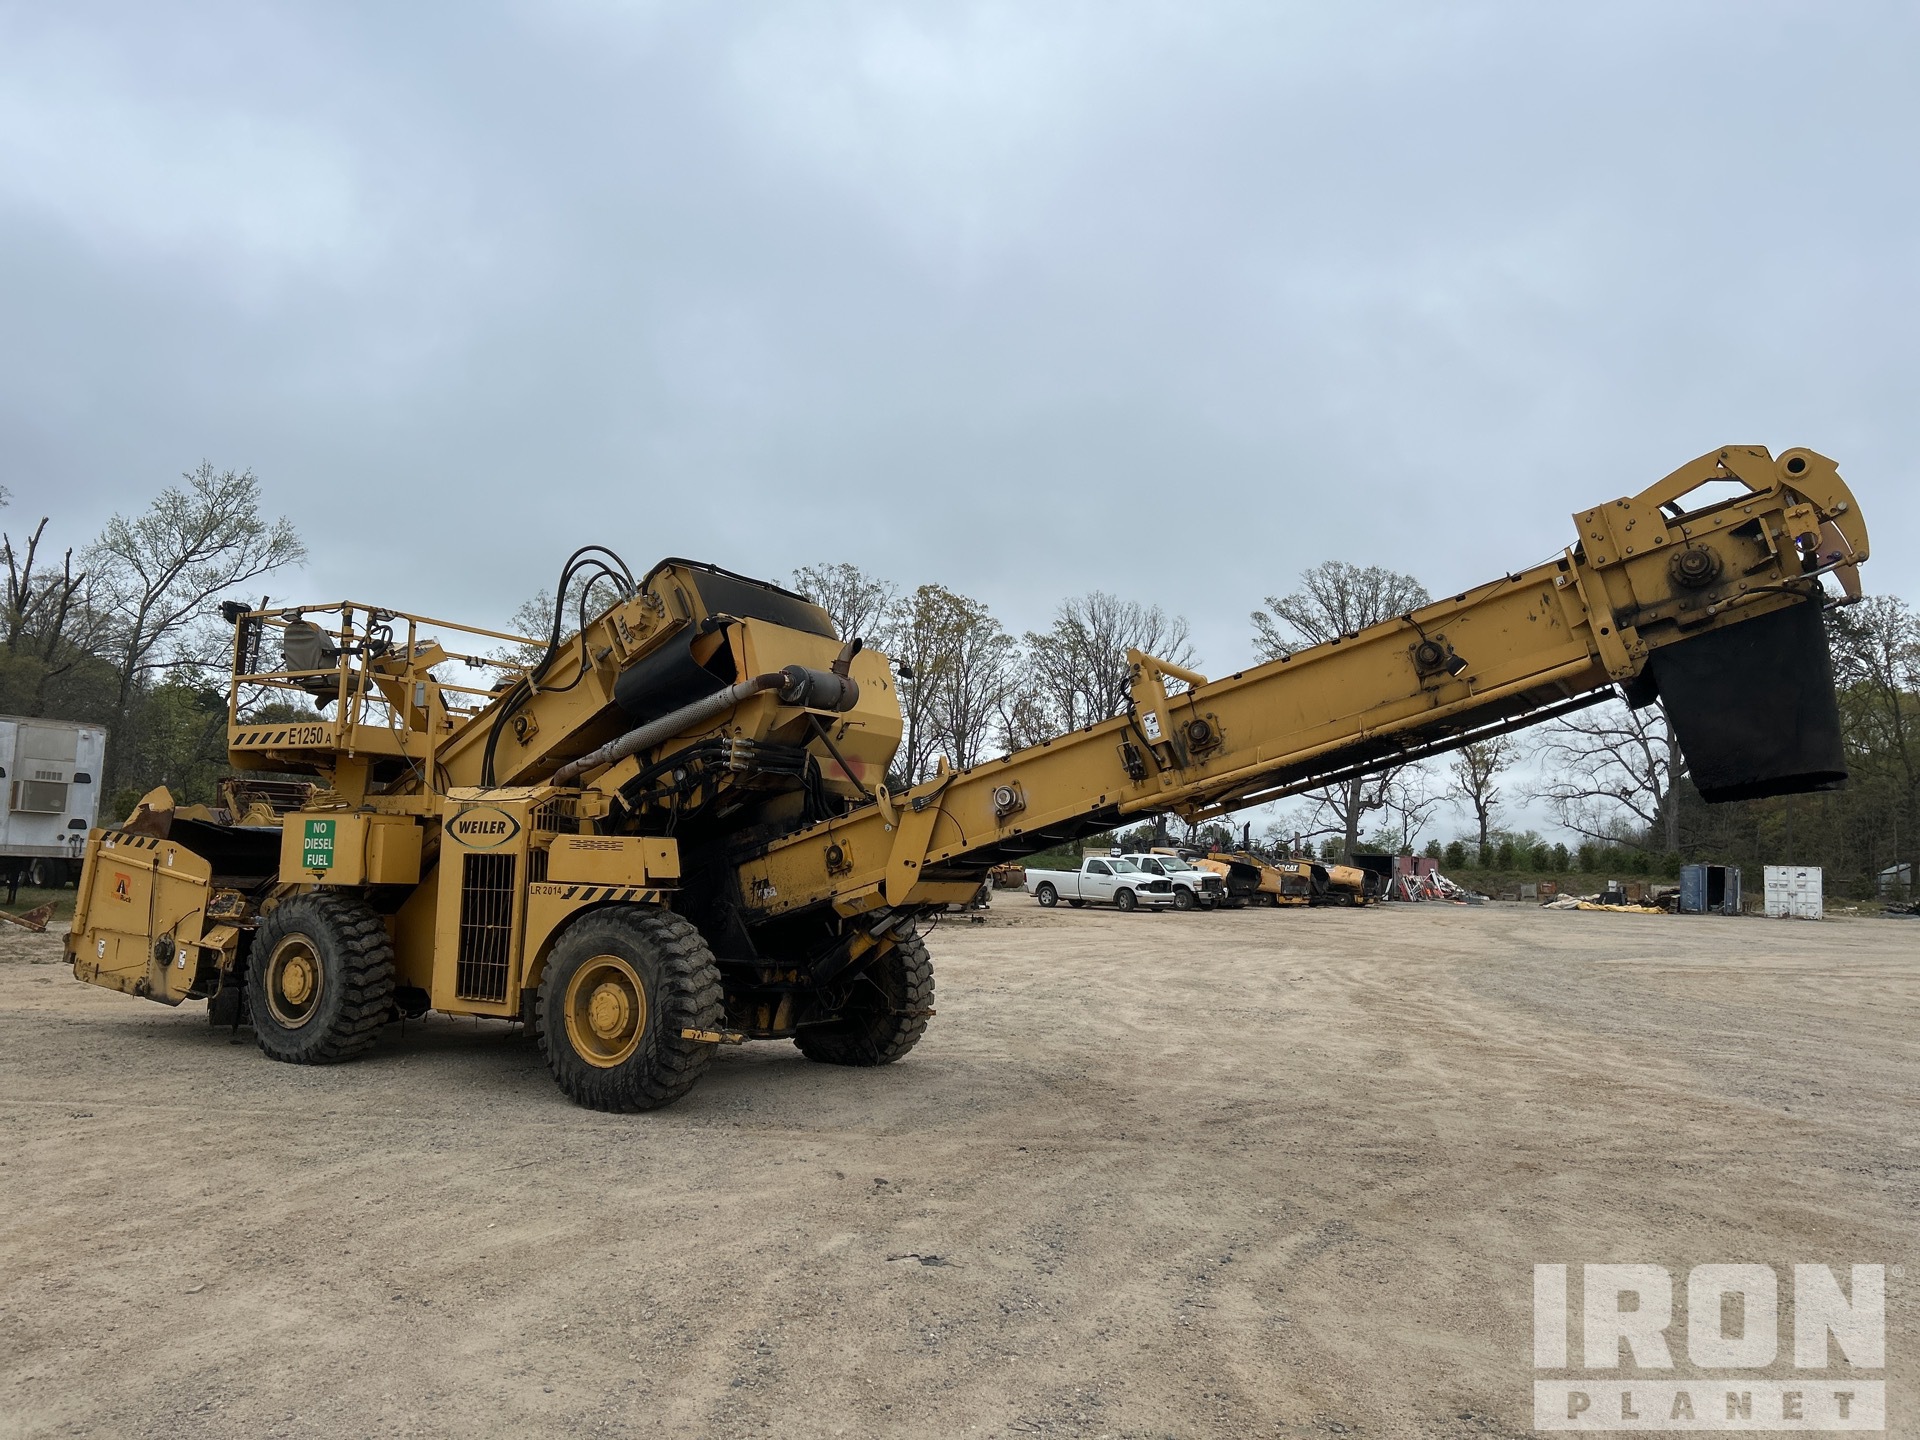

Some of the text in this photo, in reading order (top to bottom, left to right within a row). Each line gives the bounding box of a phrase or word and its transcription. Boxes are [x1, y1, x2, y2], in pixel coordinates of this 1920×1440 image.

[288, 727, 331, 744] E1250 A
[313, 822, 327, 833] NO
[459, 821, 506, 834] WEILER
[304, 838, 333, 849] DIESEL
[307, 854, 328, 865] FUEL
[1285, 864, 1298, 872] CAT
[530, 886, 562, 895] LR 2014
